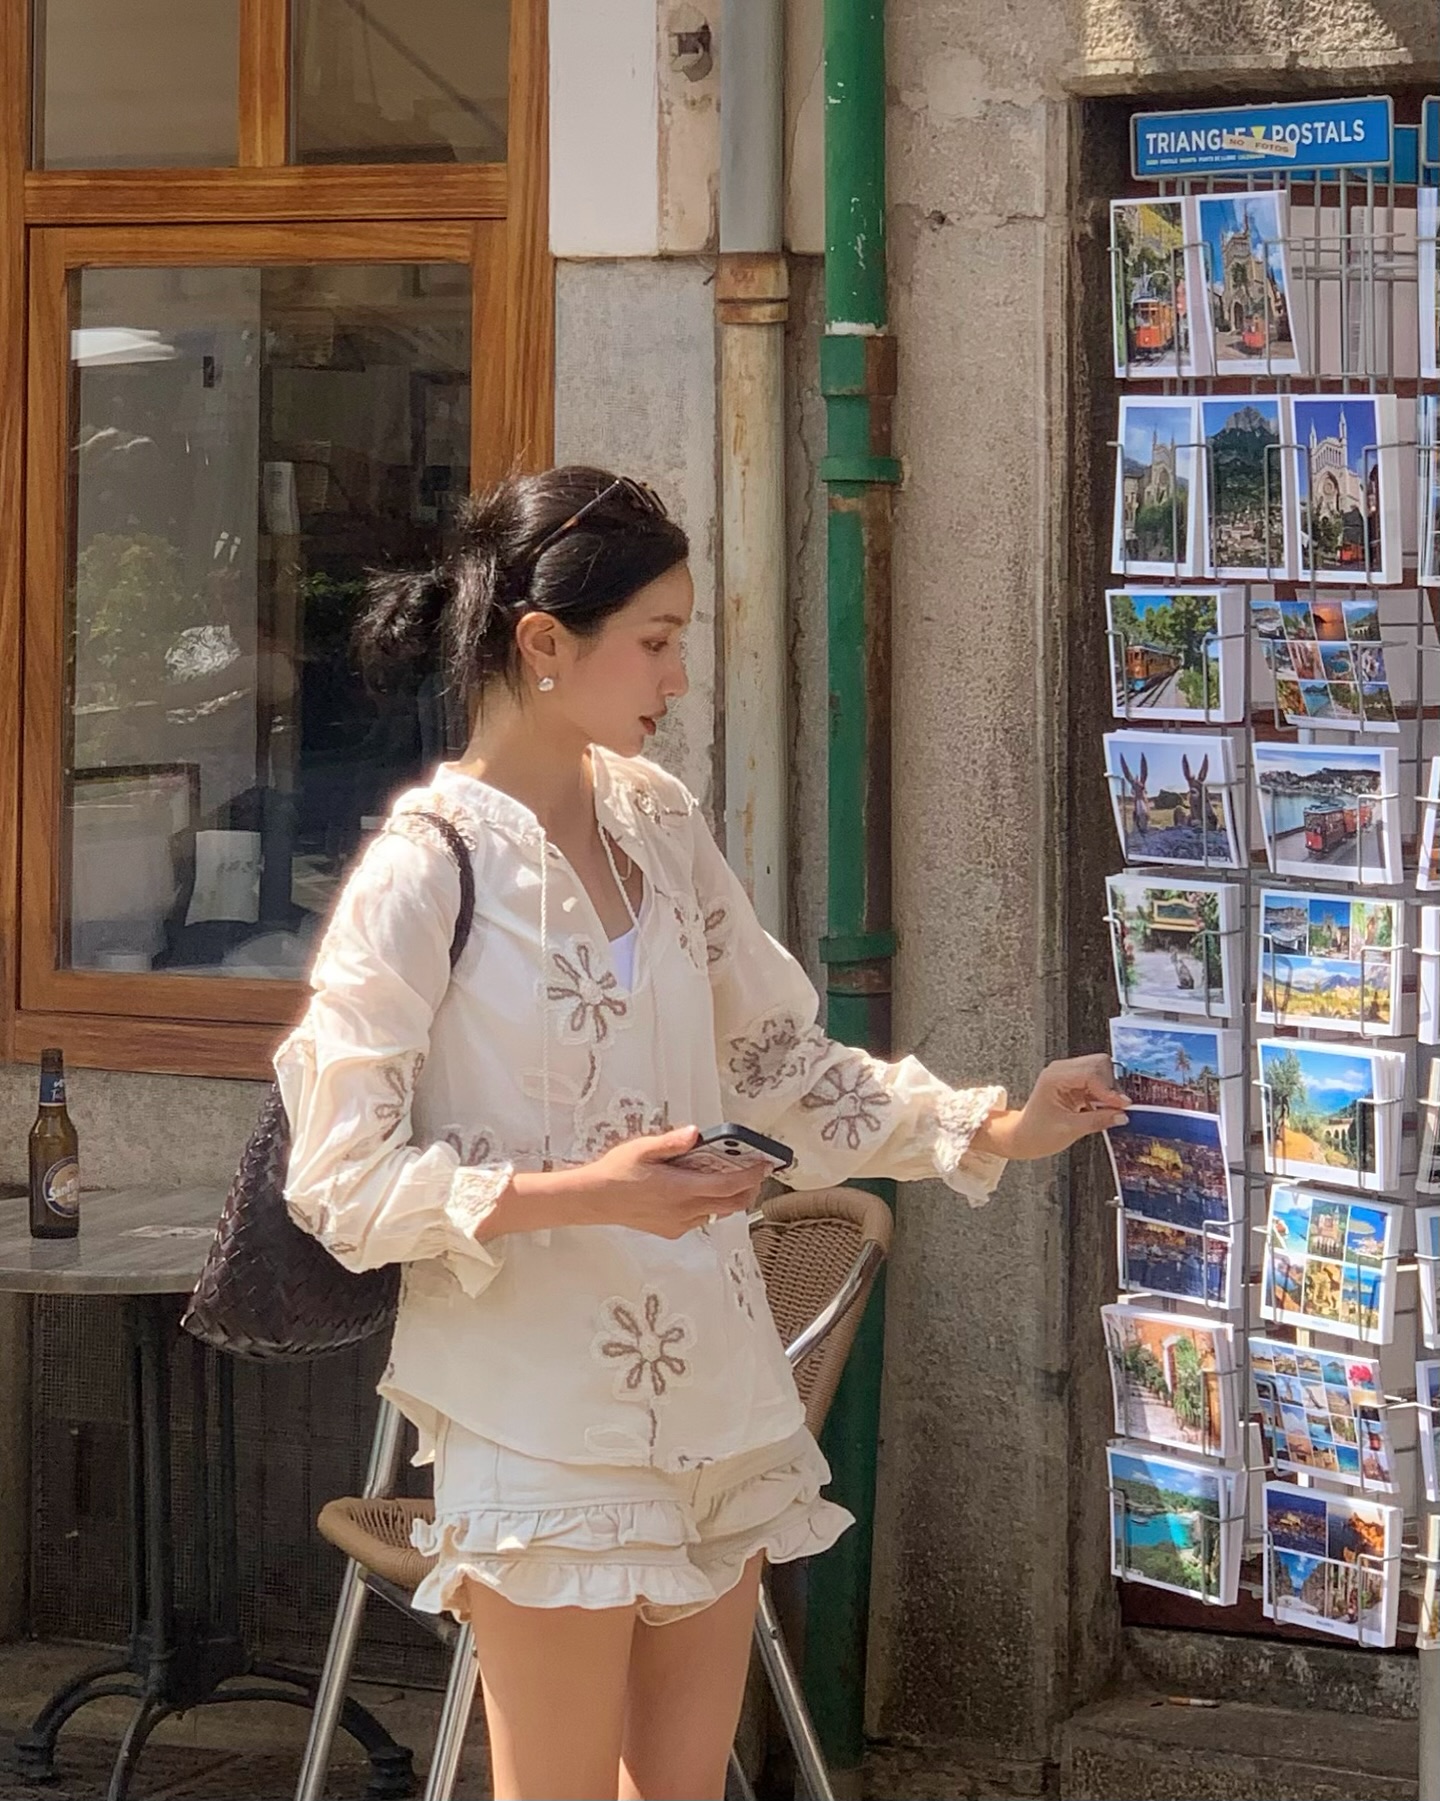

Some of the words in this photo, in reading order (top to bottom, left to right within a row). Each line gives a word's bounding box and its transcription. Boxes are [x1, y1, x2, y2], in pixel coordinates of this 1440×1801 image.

[1272, 119, 1366, 145] POSTALS
[1229, 138, 1245, 146] NO
[1255, 142, 1289, 153] FOTOS
